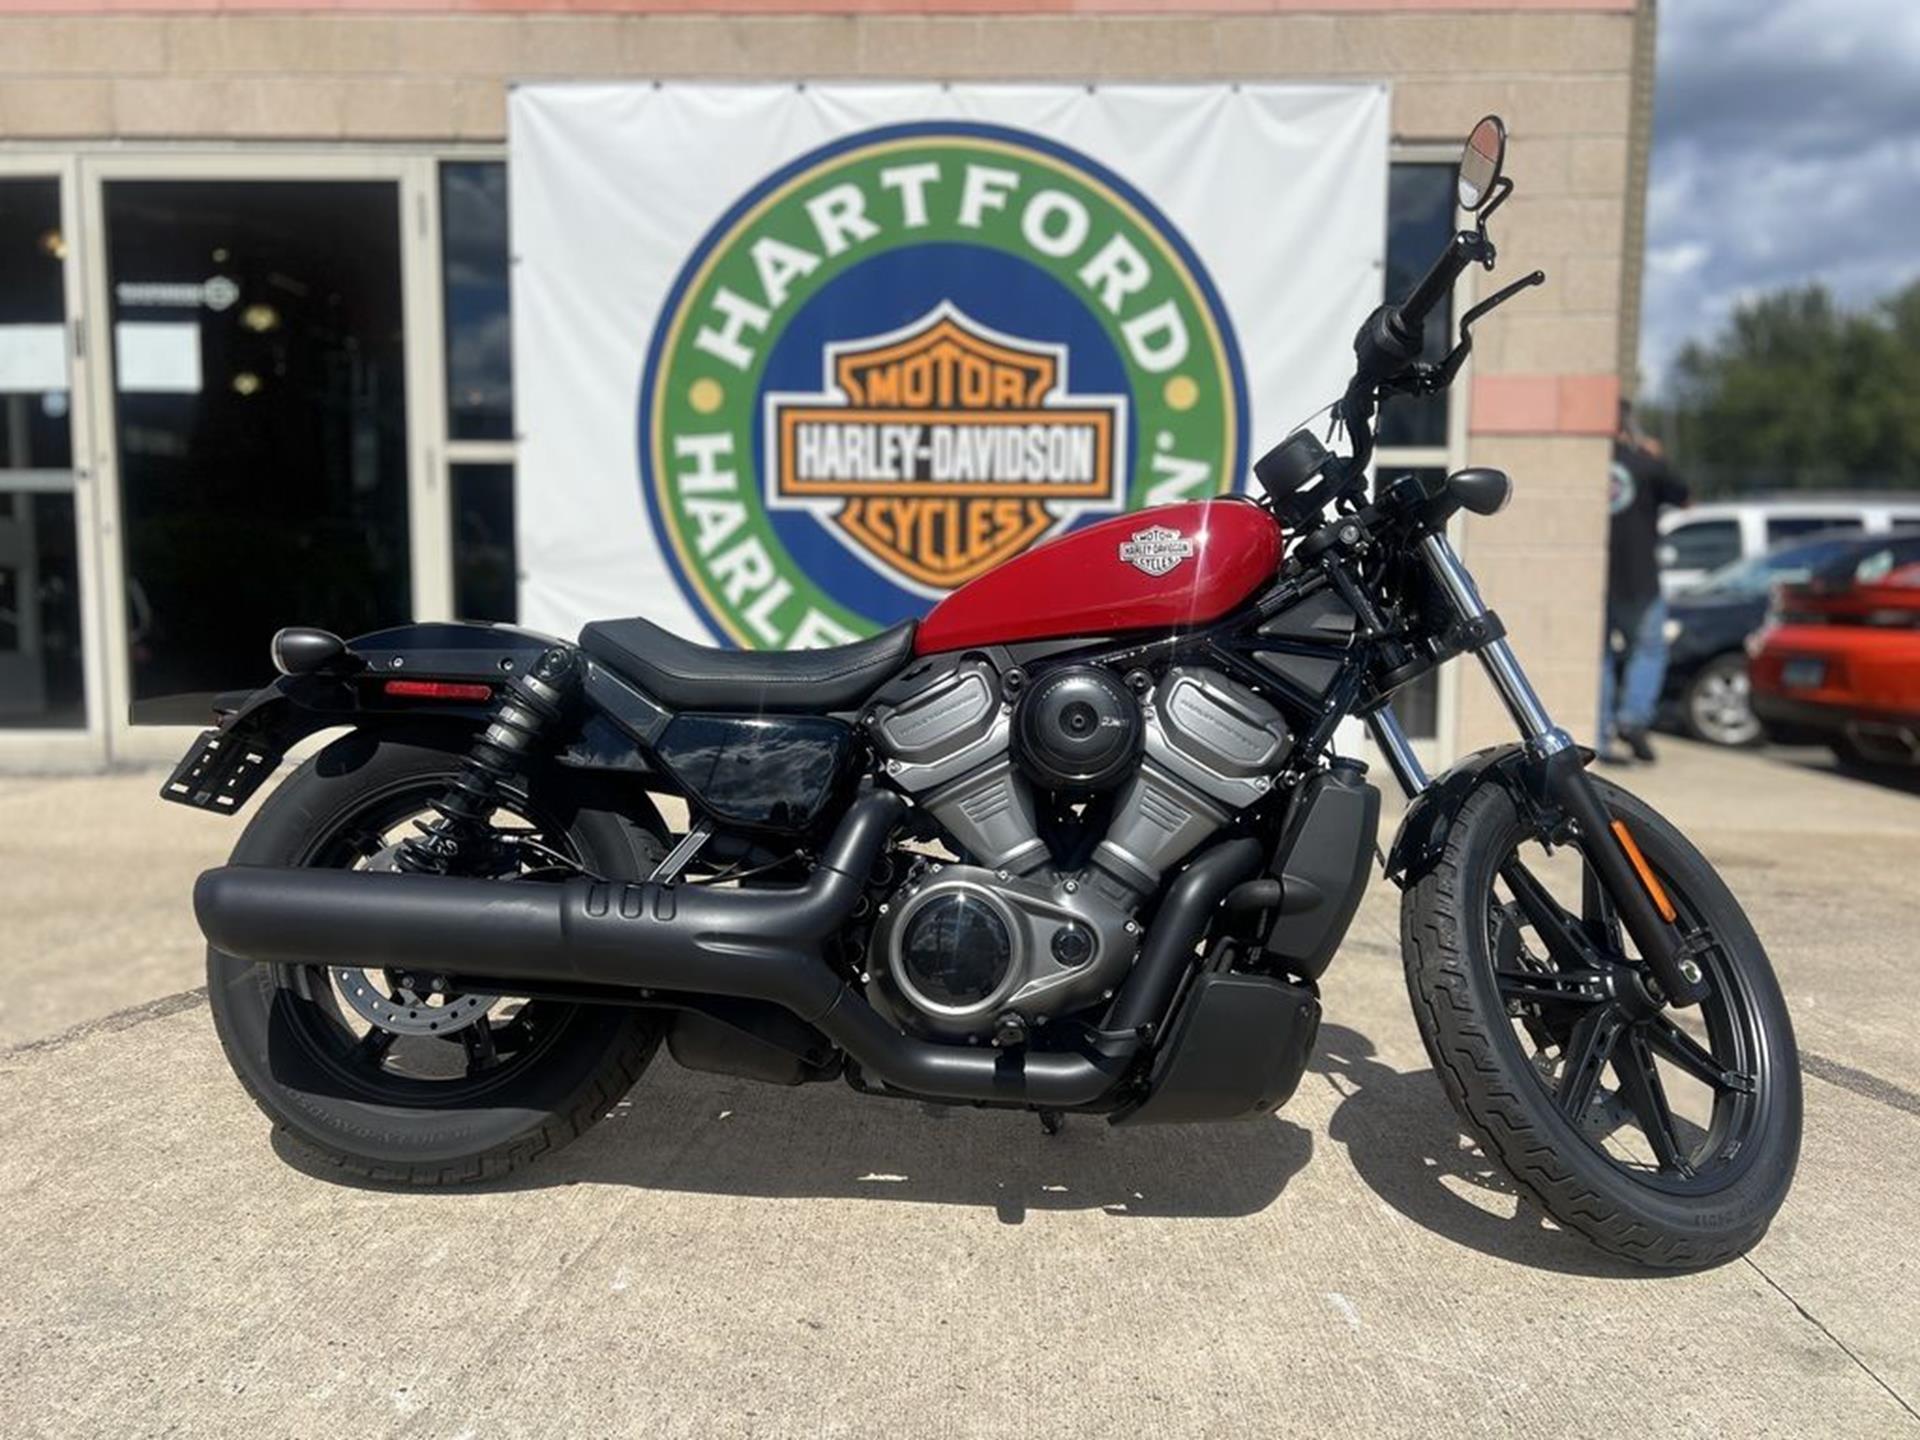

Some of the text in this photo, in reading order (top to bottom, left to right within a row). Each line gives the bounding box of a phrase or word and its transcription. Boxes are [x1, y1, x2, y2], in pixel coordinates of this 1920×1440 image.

[694, 161, 1190, 372] HARTFORD
[866, 344, 1025, 406] MOTOR
[797, 423, 1093, 483] HARLEY-DAVIDSON
[673, 431, 864, 650] HARLE
[864, 498, 1022, 570] CYCLES
